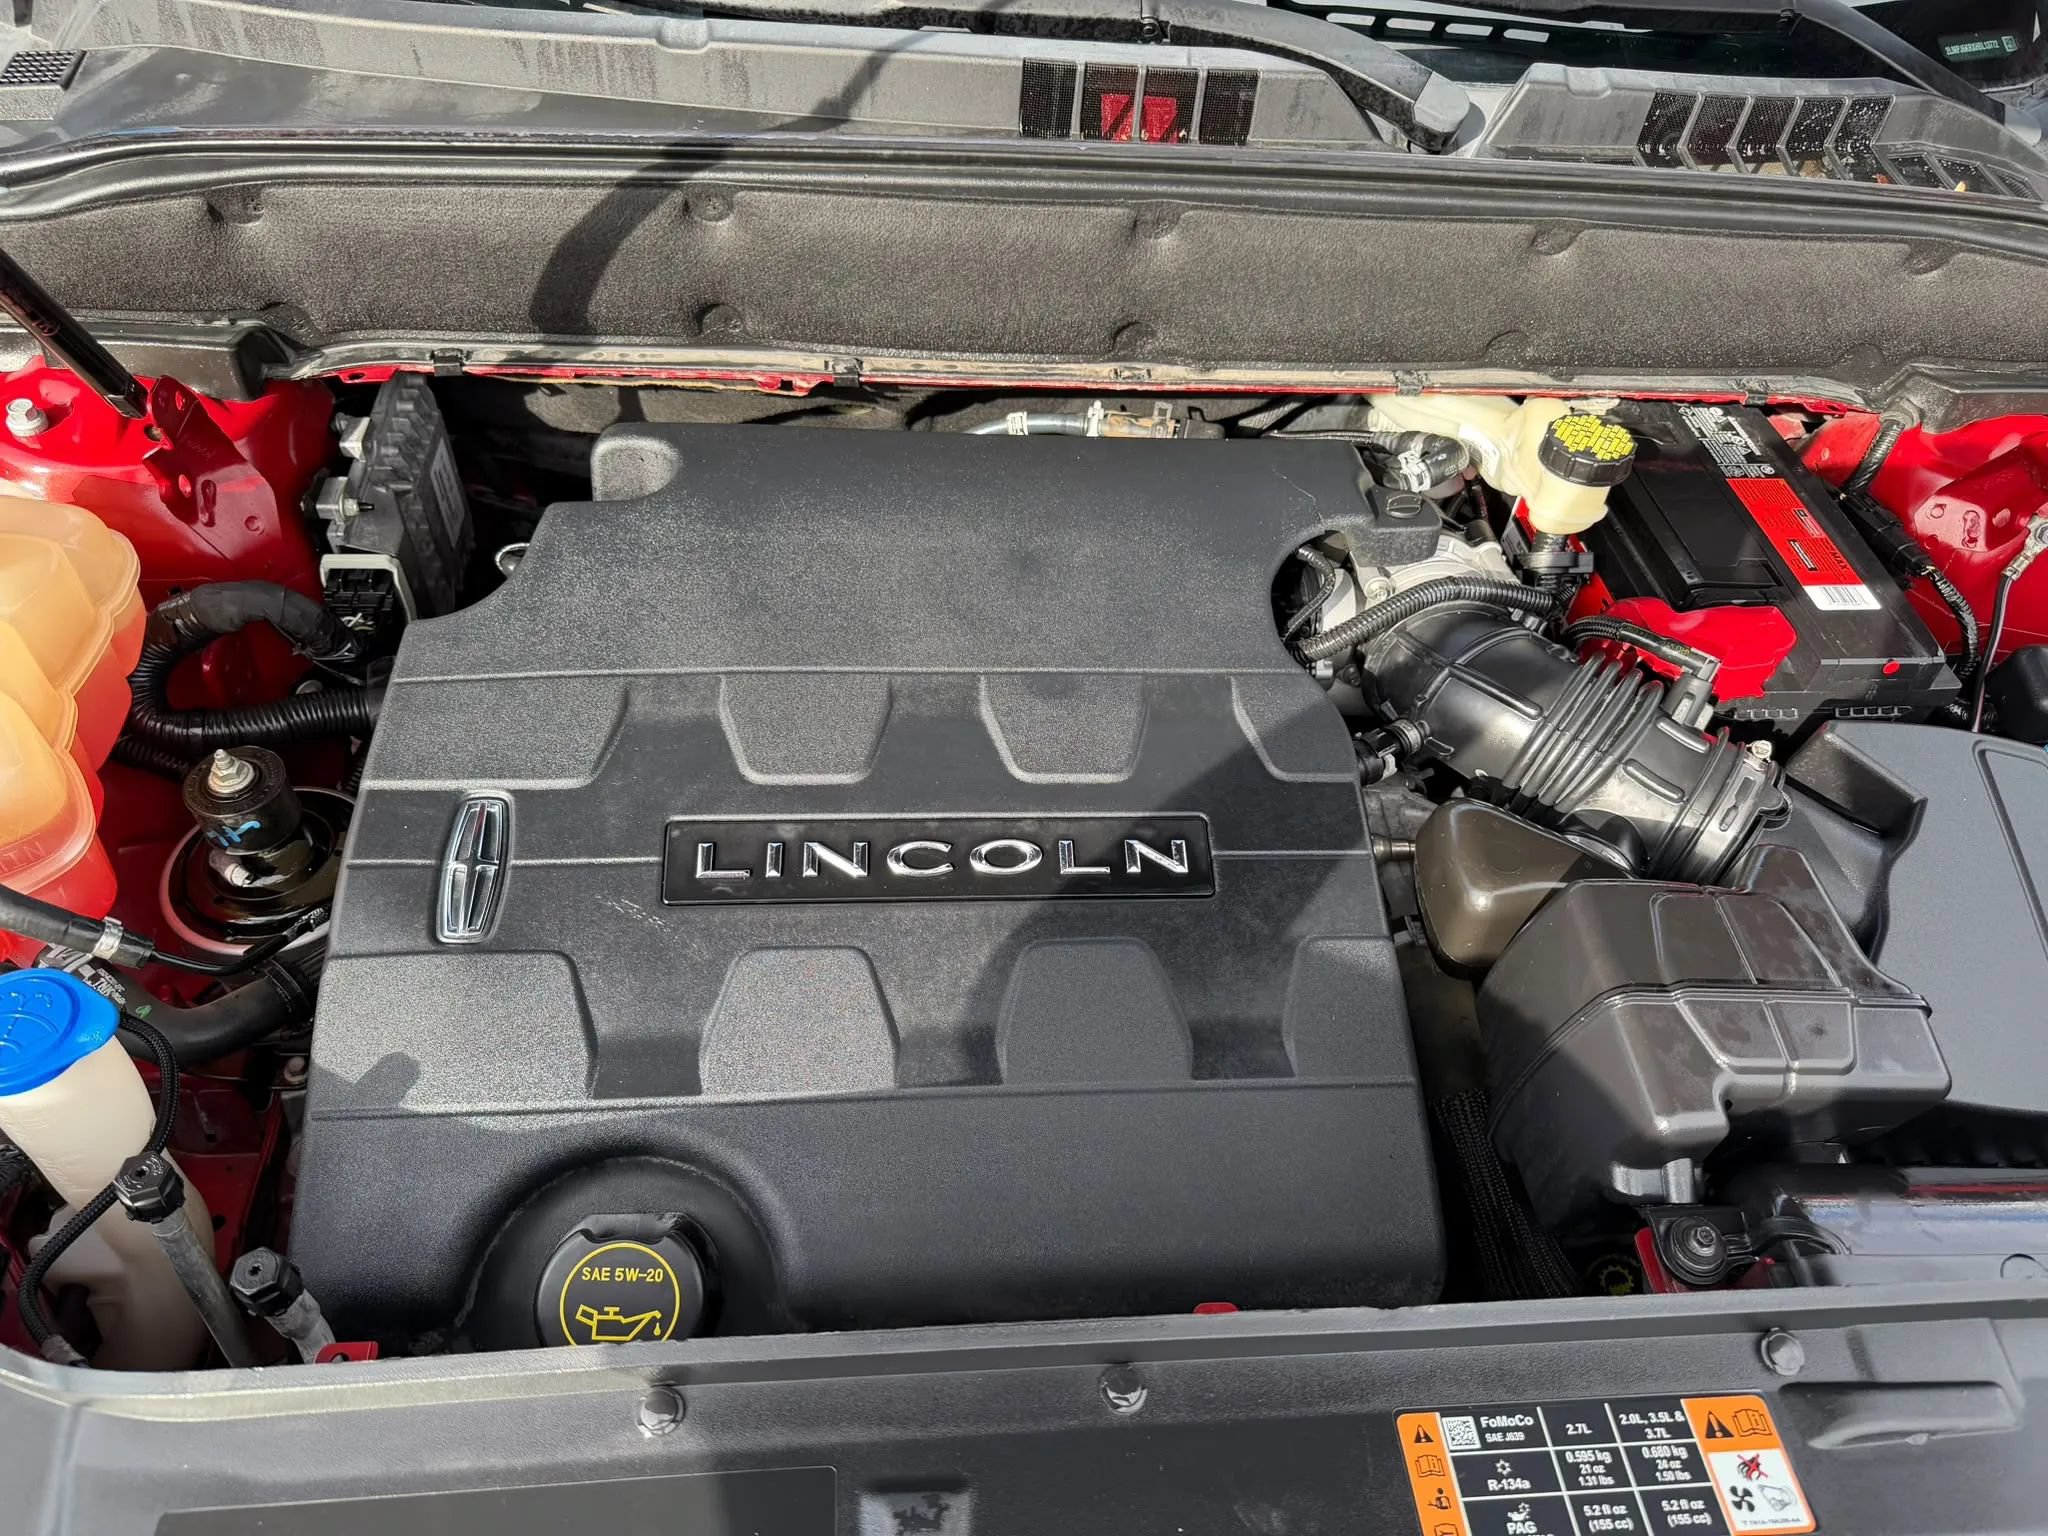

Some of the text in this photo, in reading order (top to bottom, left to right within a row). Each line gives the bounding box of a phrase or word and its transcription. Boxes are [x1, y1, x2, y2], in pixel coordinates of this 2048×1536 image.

[695, 838, 1188, 878] LINCOLN
[581, 1267, 664, 1282] SAE 5W-20
[1480, 1414, 1534, 1428] FoMoCo
[1619, 1411, 1685, 1425] 2.0L, 3.5L &
[1565, 1423, 1592, 1435] 2.7L
[1645, 1427, 1672, 1439] 3.7L
[1485, 1432, 1525, 1442] SAE J639
[1565, 1449, 1613, 1464] 0.595 kg
[1671, 1445, 1688, 1459] kg
[1579, 1464, 1606, 1474] 21 oz
[1669, 1460, 1683, 1469] oz
[1578, 1475, 1615, 1486] 1.31 lbs
[1675, 1470, 1692, 1480] lbs
[1487, 1478, 1532, 1491] R-134a
[1583, 1504, 1628, 1516] 5.2 fl oz
[1661, 1500, 1680, 1511] 5.2
[1690, 1500, 1706, 1510] oz
[1588, 1517, 1634, 1533] (155 cc)
[1692, 1512, 1712, 1526] cc)
[1506, 1521, 1538, 1535] PAG
